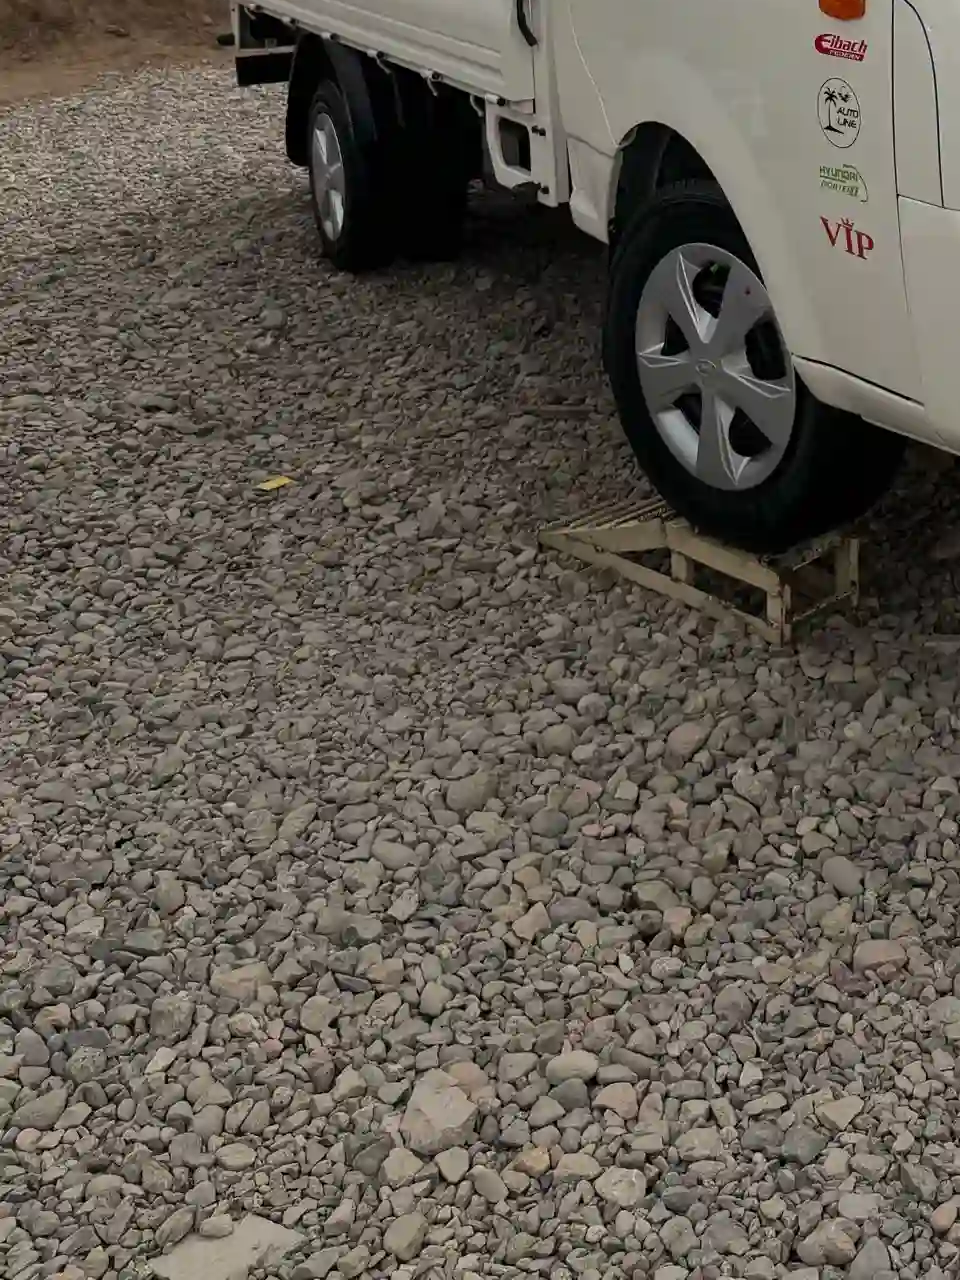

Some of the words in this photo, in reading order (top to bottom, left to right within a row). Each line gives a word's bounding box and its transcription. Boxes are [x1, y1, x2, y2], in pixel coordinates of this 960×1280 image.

[814, 33, 868, 55] Eibach
[836, 106, 860, 119] AUTO
[837, 117, 858, 130] LINE
[819, 216, 875, 260] VIP
